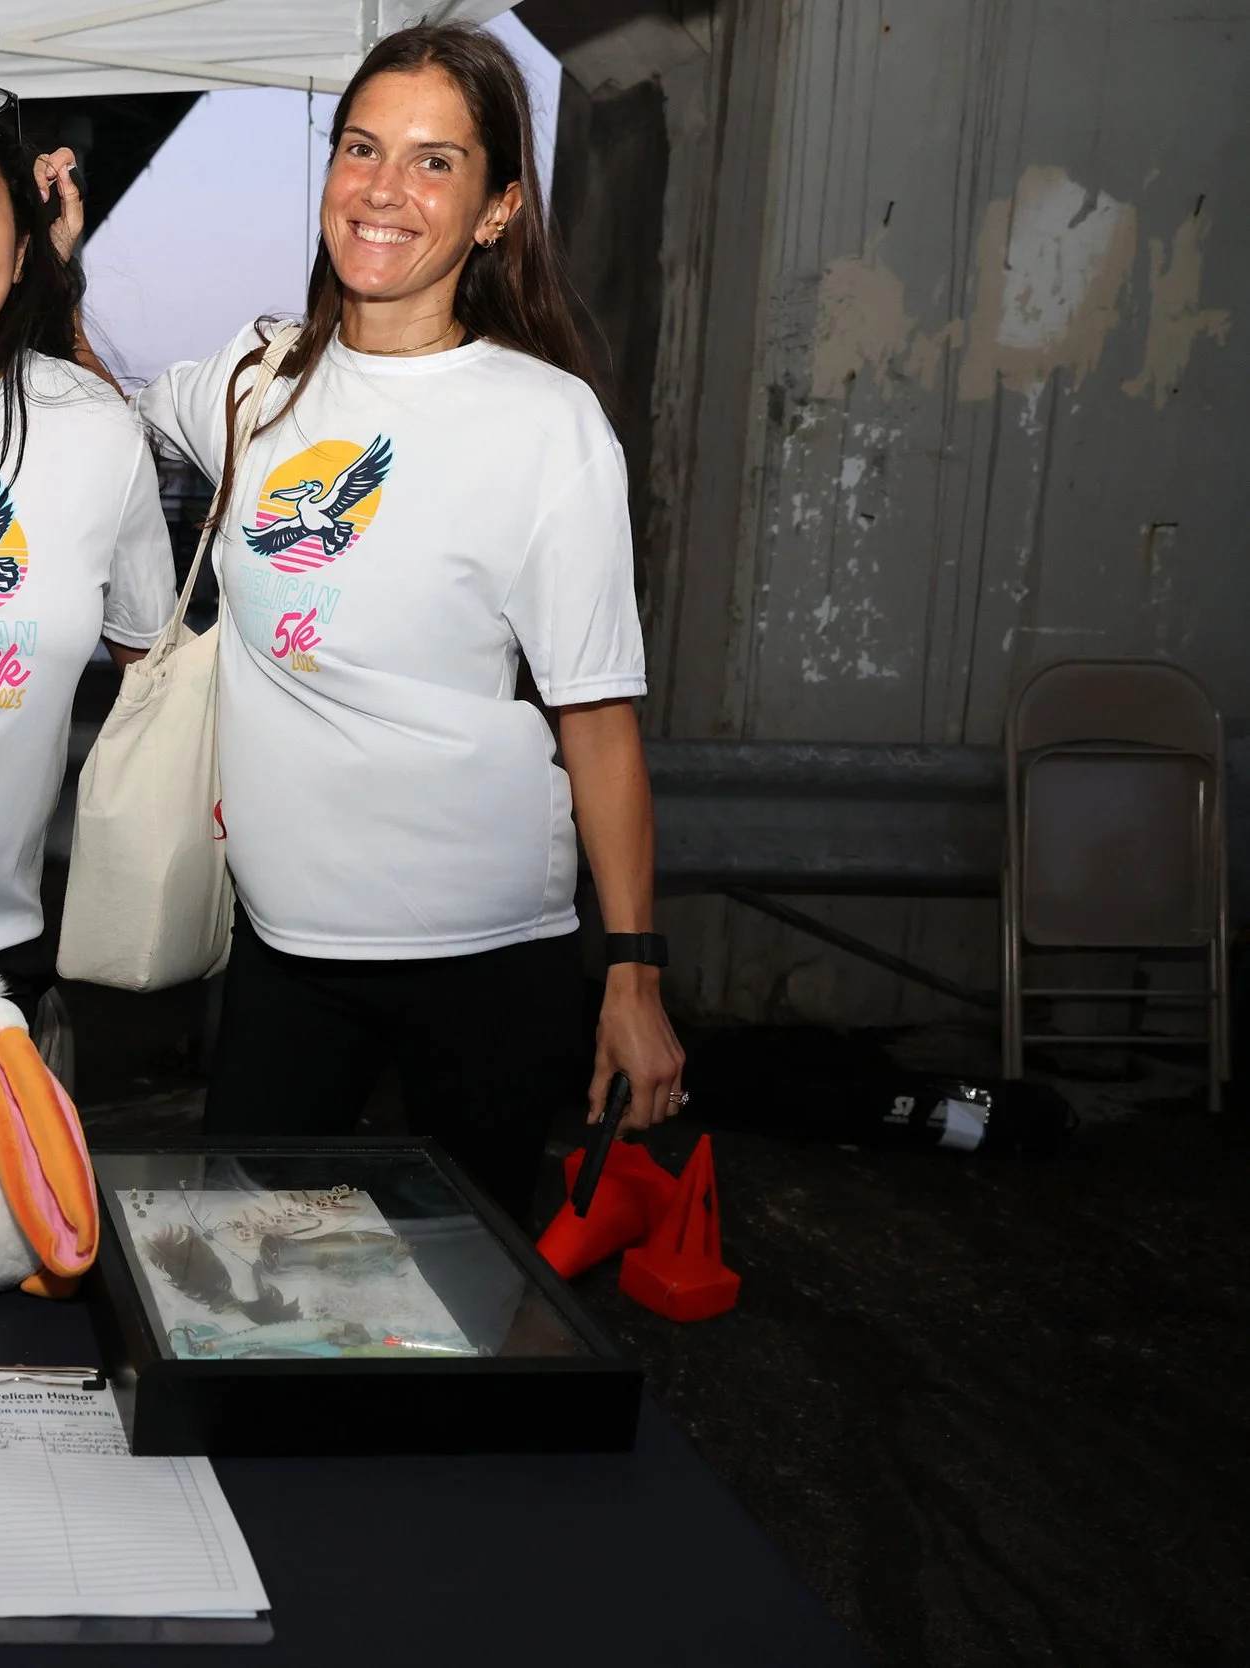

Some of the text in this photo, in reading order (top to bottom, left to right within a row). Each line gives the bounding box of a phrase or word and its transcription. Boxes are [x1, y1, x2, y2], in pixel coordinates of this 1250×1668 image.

[240, 564, 341, 624] PELICAN
[271, 607, 322, 658] 5k
[290, 650, 320, 672] 2025
[47, 1391, 94, 1401] Harbor
[42, 1408, 115, 1418] NEWSLETTER!
